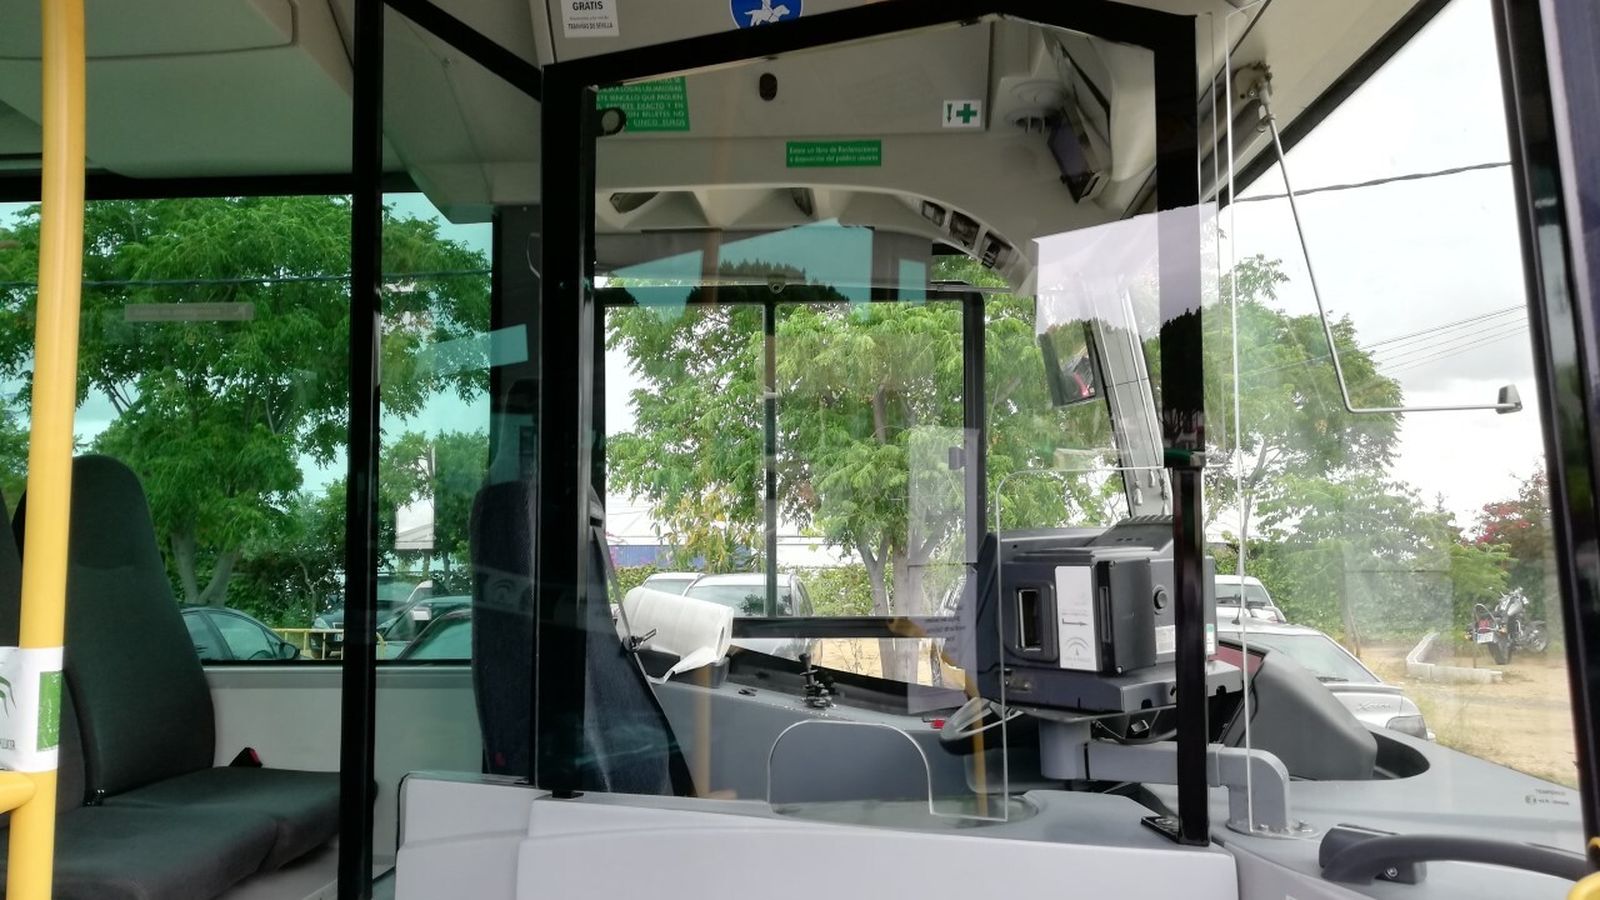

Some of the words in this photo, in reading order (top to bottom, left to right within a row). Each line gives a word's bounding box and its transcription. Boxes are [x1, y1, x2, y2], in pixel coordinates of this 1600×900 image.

[572, 1, 603, 11] GRATIS
[673, 110, 685, 118] NO
[633, 119, 658, 127] CINCO
[662, 119, 686, 127] EUROS
